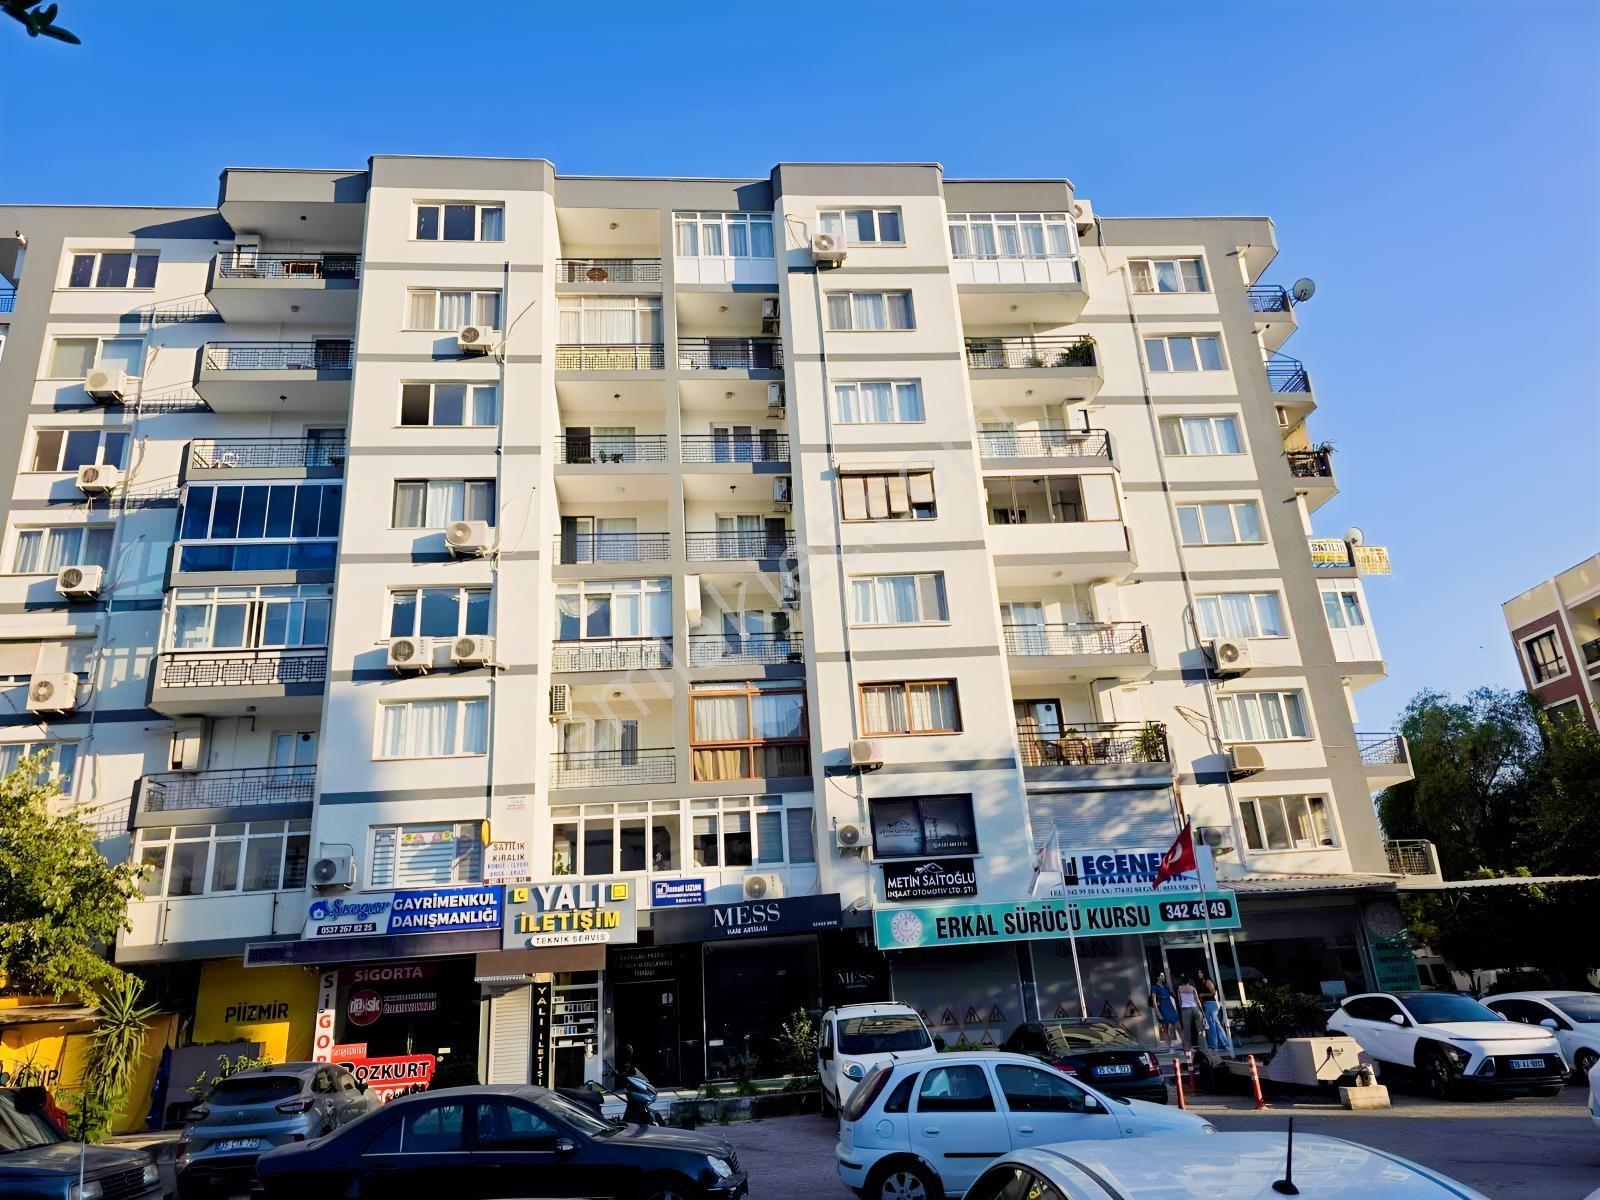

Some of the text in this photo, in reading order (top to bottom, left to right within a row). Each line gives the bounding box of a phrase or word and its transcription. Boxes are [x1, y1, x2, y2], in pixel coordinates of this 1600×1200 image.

[887, 875, 920, 889] METİN
[393, 893, 497, 911] GAYRİMENKUL
[537, 882, 605, 910] YALI
[392, 908, 497, 928] DANIŞMANLIĞI
[520, 908, 620, 932] İLETİŞİM
[712, 902, 781, 928] MESS
[1166, 901, 1226, 919] 342 49 49
[936, 905, 1151, 939] ERKAL SÜRÜCÜ KURSU
[225, 1000, 289, 1023] PİİZMİR
[537, 986, 547, 1026] YALI
